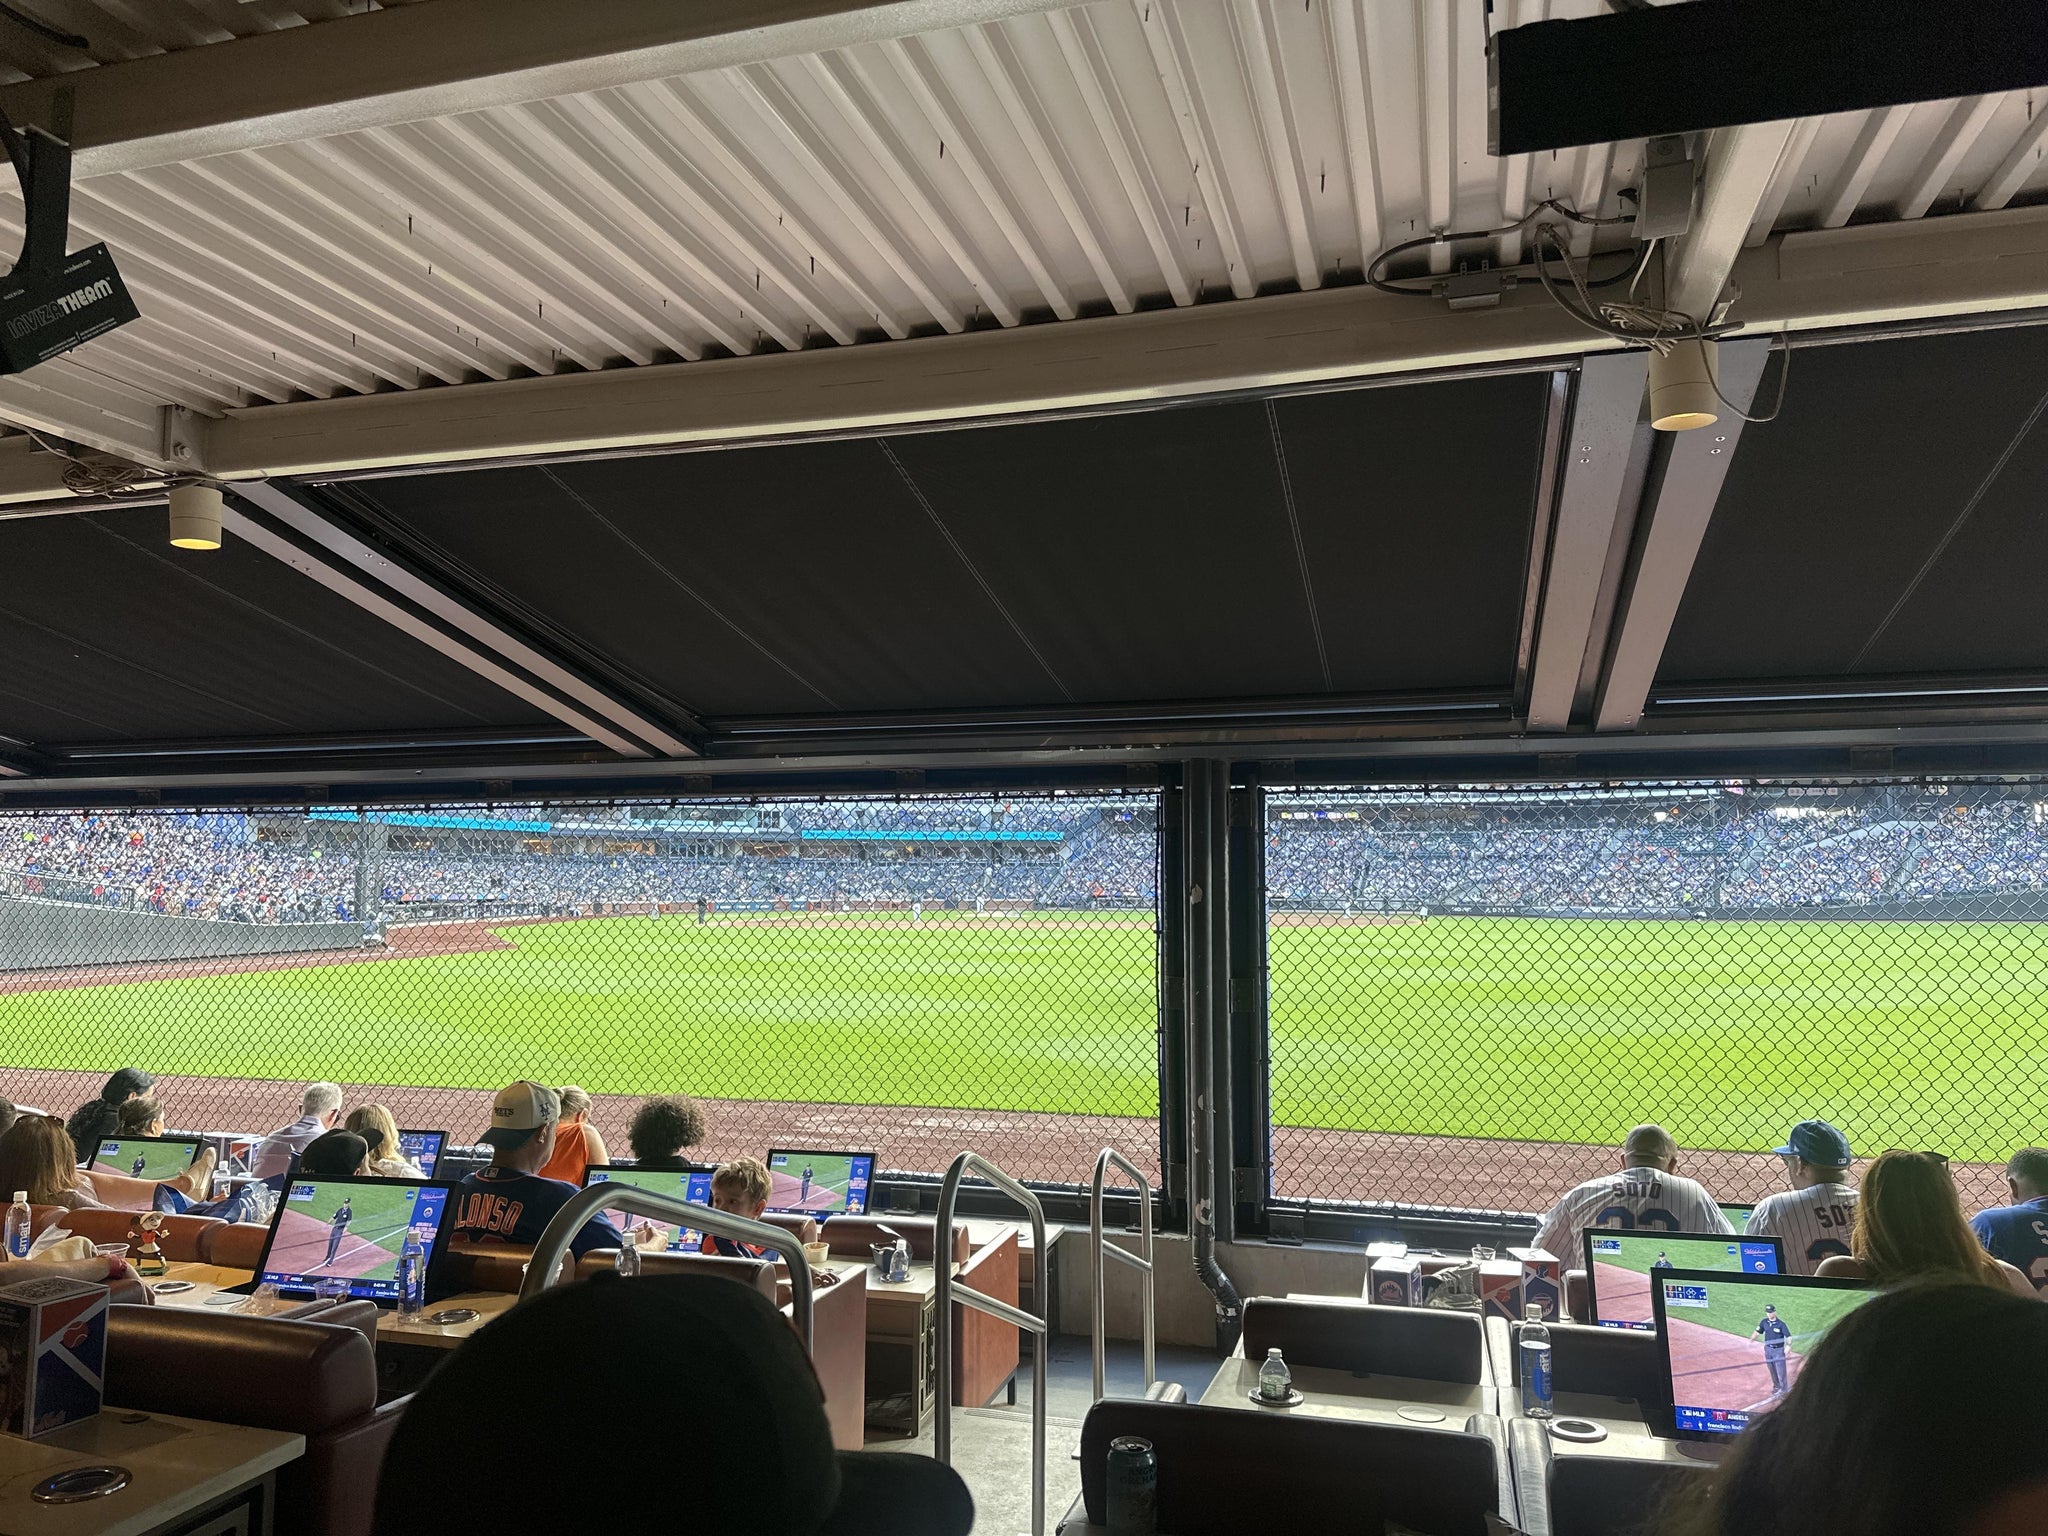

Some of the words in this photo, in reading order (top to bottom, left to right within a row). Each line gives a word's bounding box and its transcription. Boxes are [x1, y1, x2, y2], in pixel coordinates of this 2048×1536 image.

[7, 280, 113, 339] INVIZATHERM
[1612, 1181, 1662, 1198] SOTO
[454, 1193, 524, 1236] LONSO
[1814, 1204, 1856, 1230] SOT
[19, 1221, 30, 1254] smart
